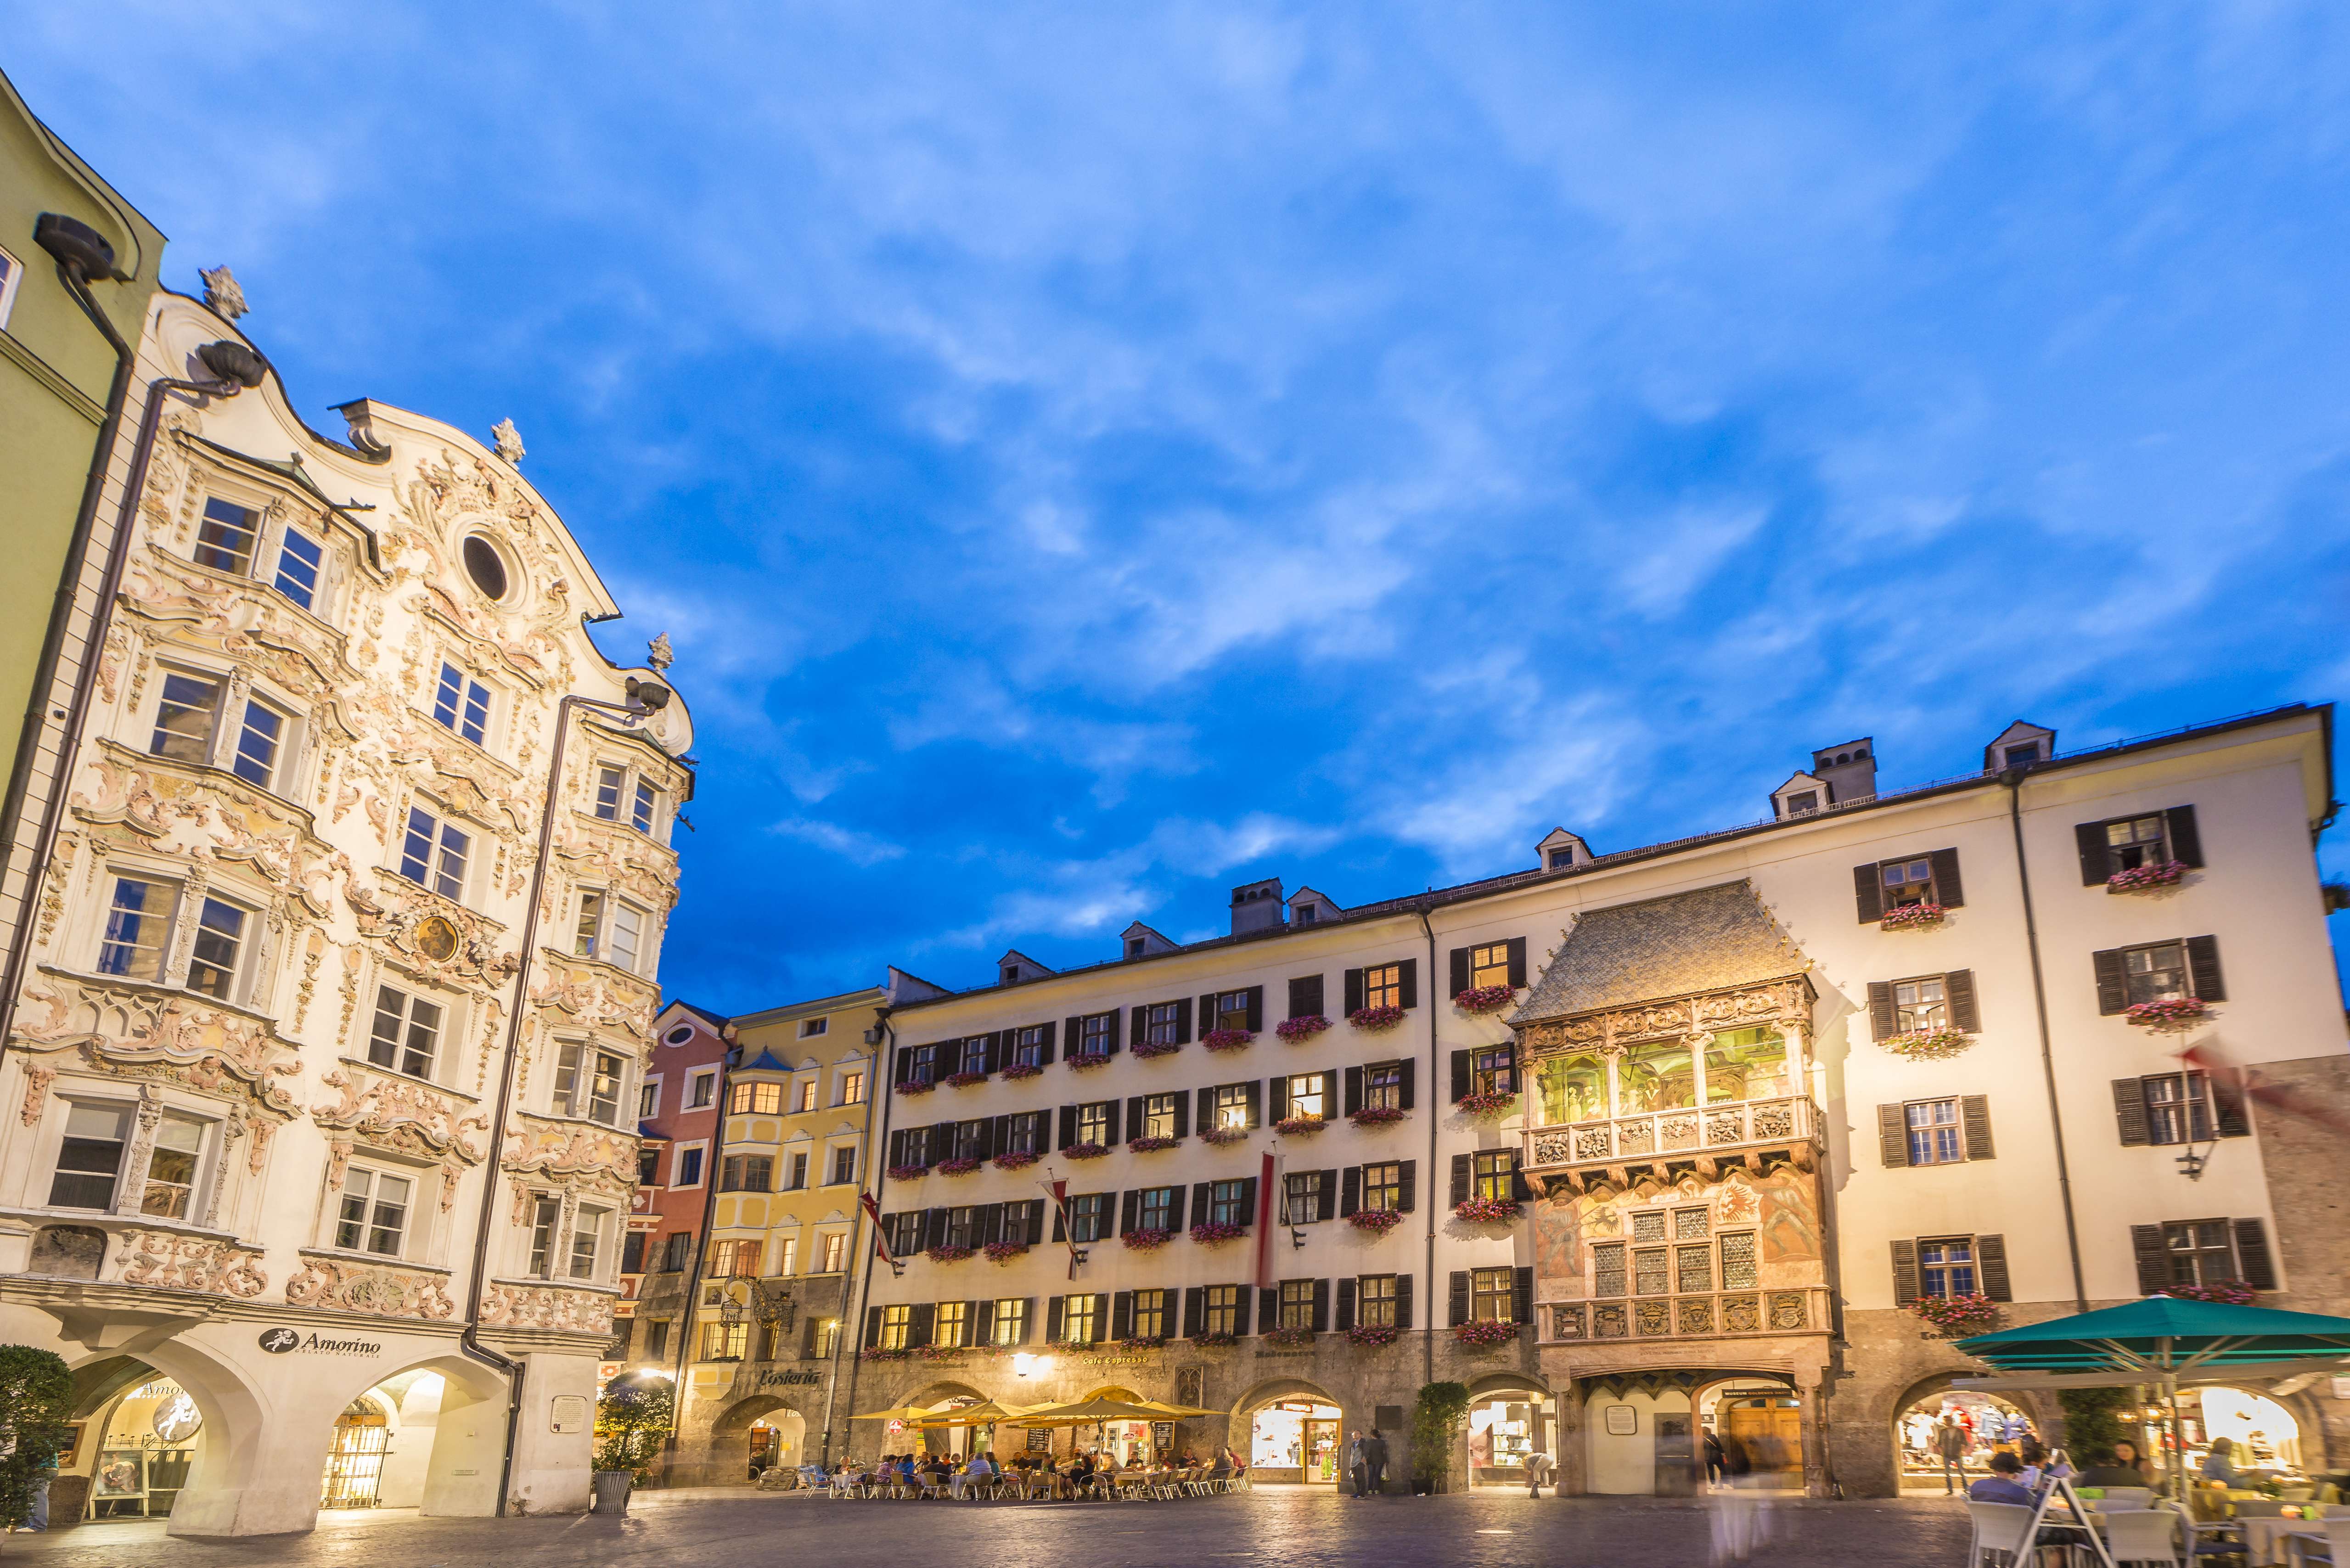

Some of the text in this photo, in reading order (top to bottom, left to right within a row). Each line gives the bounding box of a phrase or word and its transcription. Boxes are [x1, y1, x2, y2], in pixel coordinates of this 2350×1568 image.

[300, 1332, 381, 1354] Amorino
[1105, 1356, 1147, 1365] Espresso
[1484, 1355, 1510, 1363] CIRO
